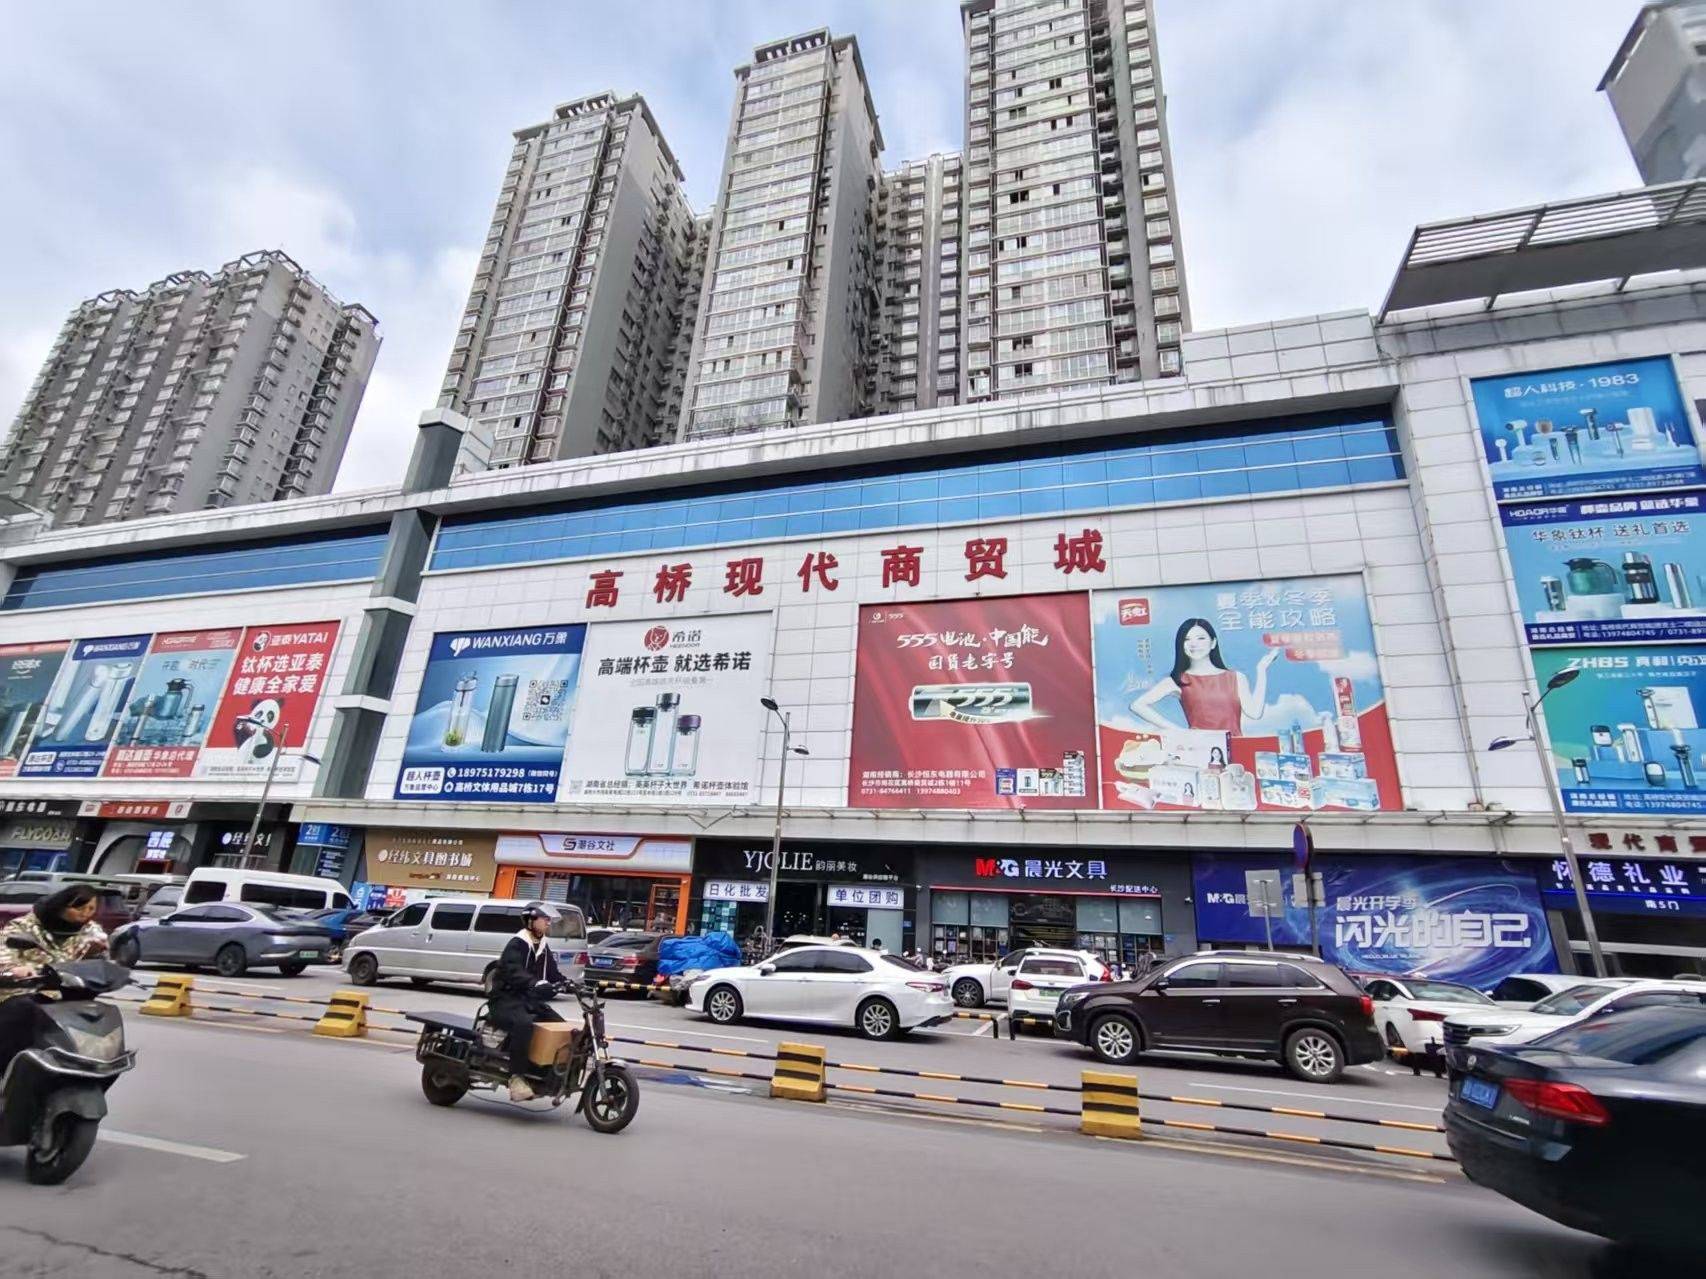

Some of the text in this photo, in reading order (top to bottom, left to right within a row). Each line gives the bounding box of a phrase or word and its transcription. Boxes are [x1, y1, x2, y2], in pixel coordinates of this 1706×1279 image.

[585, 528, 1108, 608] 高桥现代商贸城
[1217, 607, 1337, 631] 全能攻略
[241, 653, 325, 674] 钛杯选亚泰
[598, 651, 752, 676] 高端杯壶 就选希诺
[233, 674, 318, 696] 健康全家爱
[1024, 860, 1107, 879] 晨光文具
[1552, 860, 1688, 886] 怀德礼业
[709, 883, 769, 898] 日化批发
[835, 889, 899, 905] 单位团购
[1336, 909, 1531, 948] 闪光的自己
